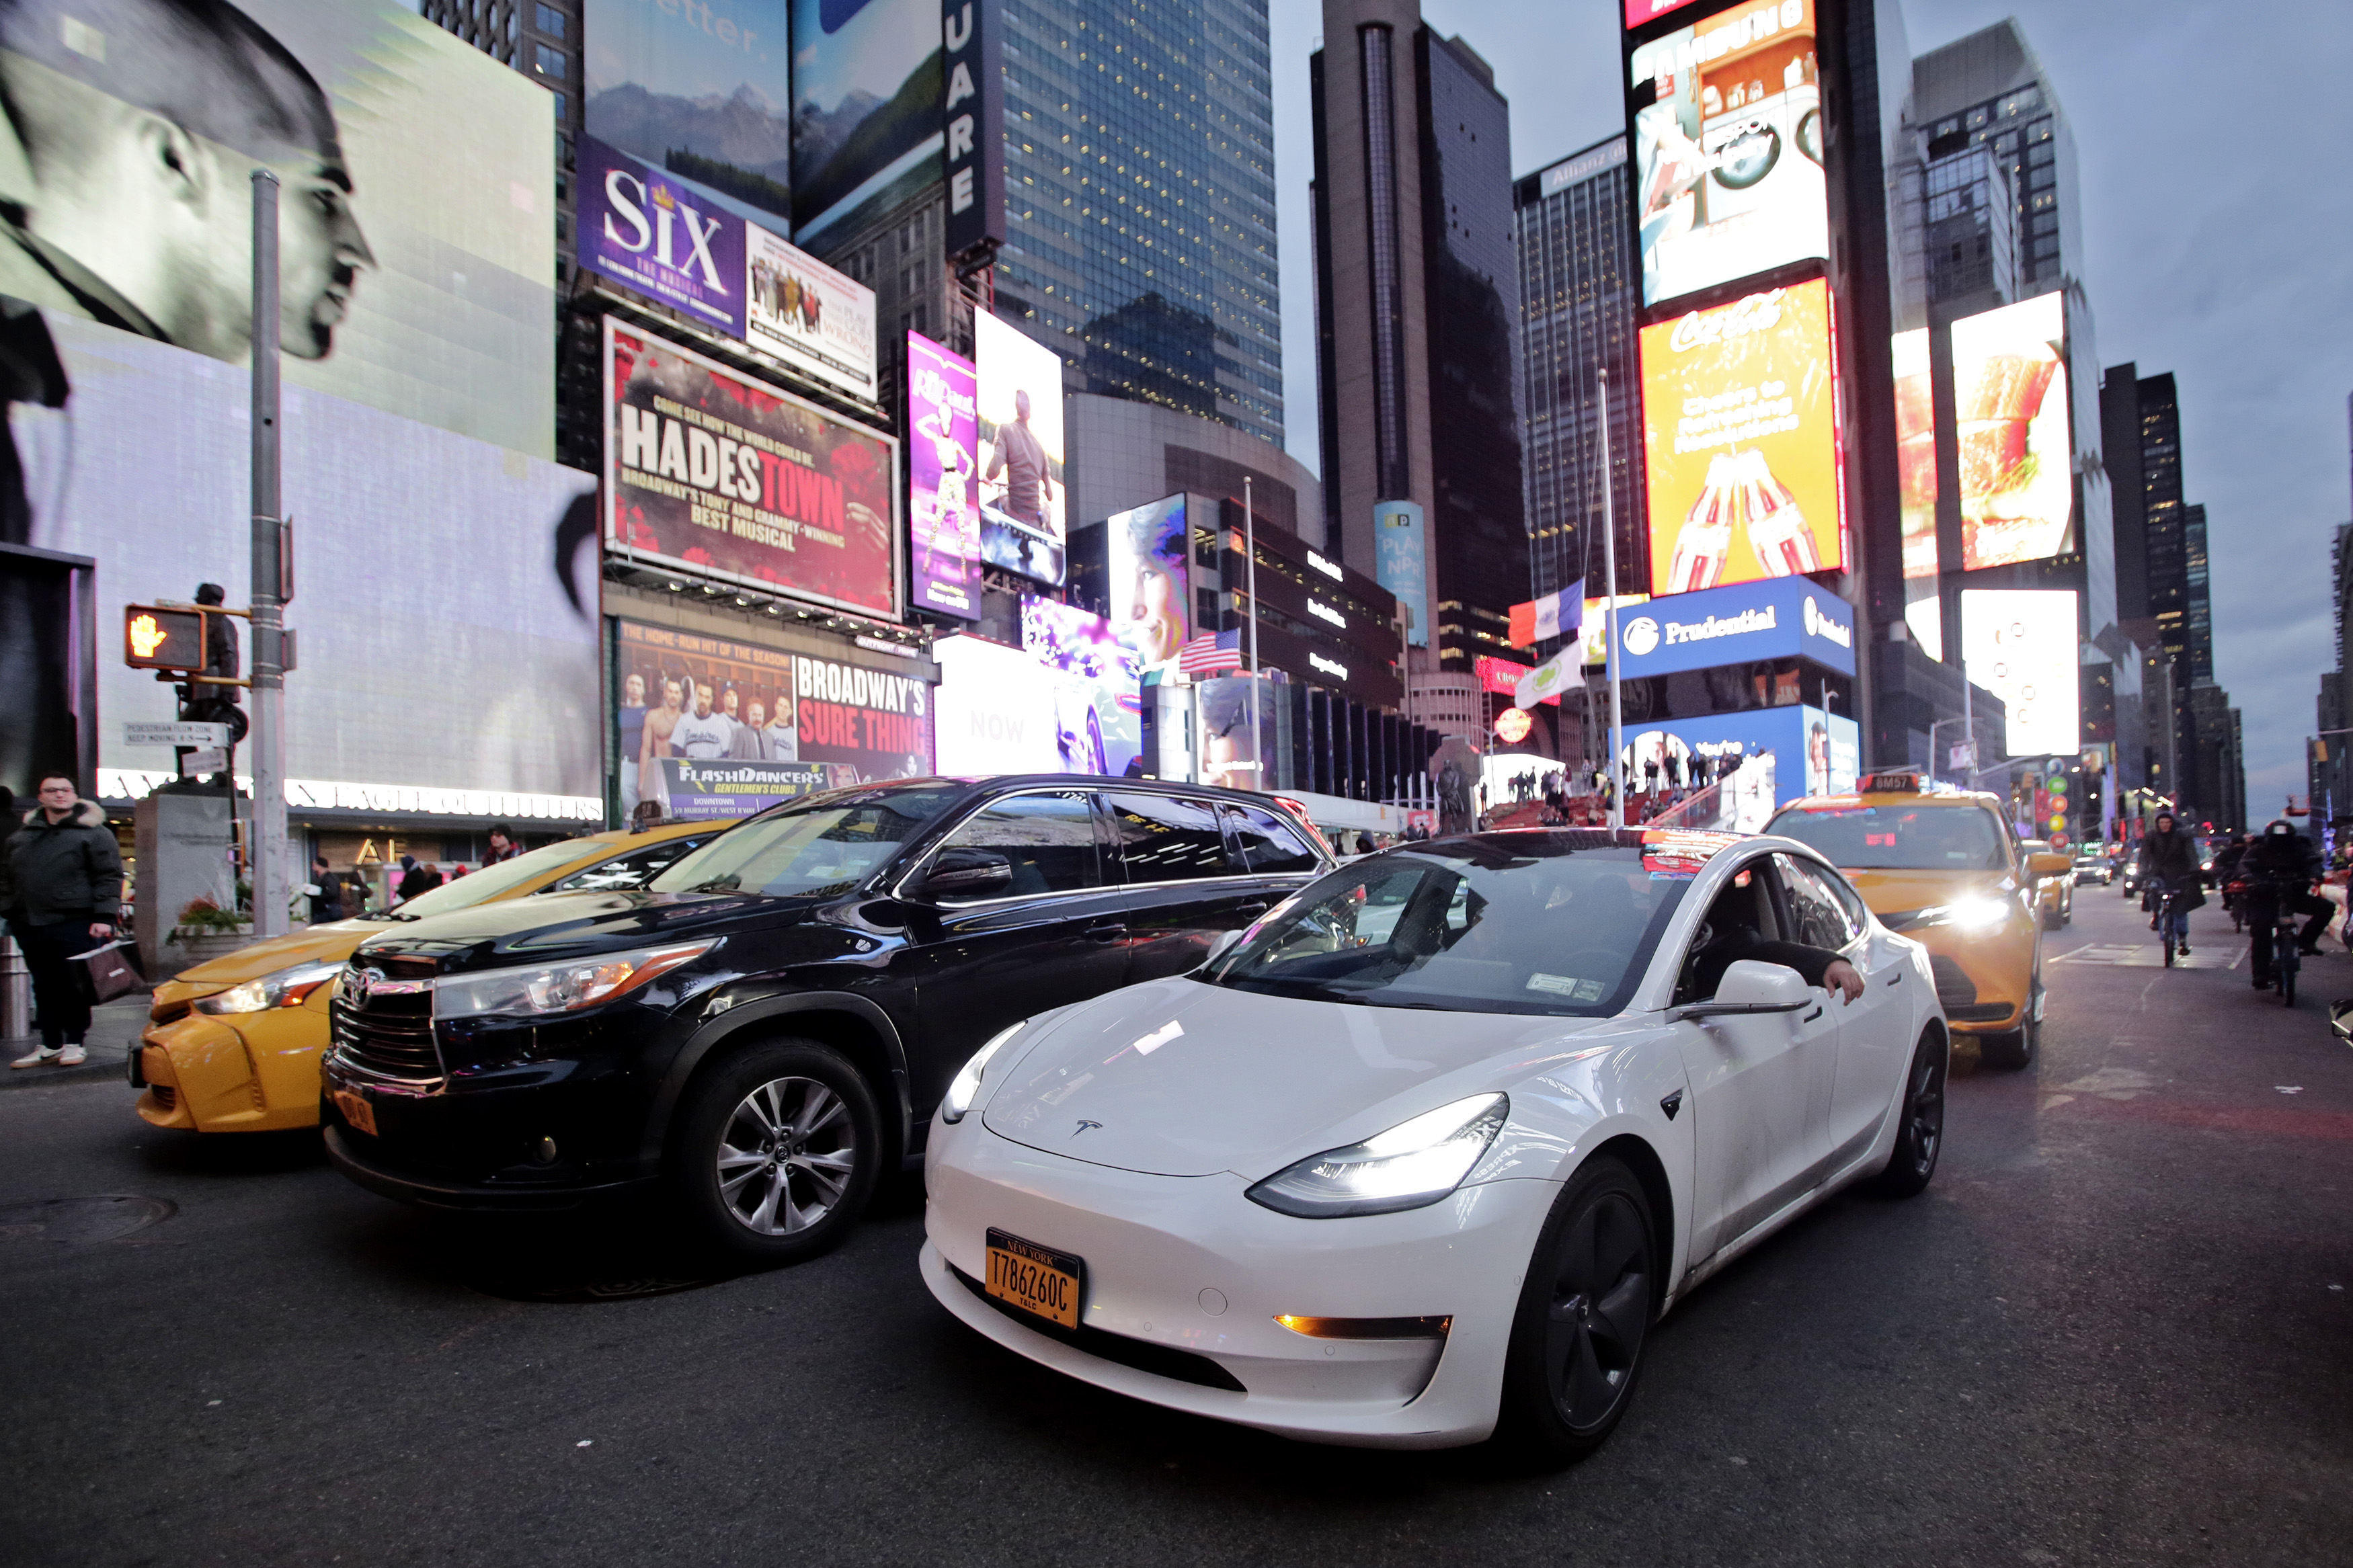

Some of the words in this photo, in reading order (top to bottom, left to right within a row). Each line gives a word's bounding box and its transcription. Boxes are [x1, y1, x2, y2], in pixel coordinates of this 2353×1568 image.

[1552, 152, 1605, 186] Allianz
[604, 169, 729, 297] SIX
[1678, 397, 1792, 438] Refreshing
[1683, 386, 1757, 417] Cheers
[1759, 380, 1786, 399] to
[653, 395, 683, 419] COME
[684, 406, 701, 427] SEE
[702, 413, 725, 435] HOW
[725, 421, 744, 442] THE
[744, 429, 775, 454] WORLD
[774, 441, 802, 464] COULD
[621, 403, 845, 532] HADESTOWN
[622, 467, 700, 504] BROADWAY'S
[699, 490, 731, 513] TONY
[731, 501, 754, 522] AND
[691, 503, 731, 533] BEST
[731, 516, 797, 546] MUSICAL
[1665, 605, 1777, 645] Prudential
[623, 623, 643, 640] THE
[645, 626, 701, 651] HOME-RUN
[701, 638, 717, 655] HIT
[719, 641, 732, 657] OF
[733, 645, 751, 661] THE
[752, 649, 791, 668] SEASON!
[858, 637, 895, 655] OUTFRONT
[798, 657, 925, 717] BROADWAY'S
[126, 725, 172, 733] PEDESTRIAN
[127, 734, 147, 742] KEEP
[149, 735, 176, 743] MOVING
[799, 699, 860, 749] SURE
[862, 709, 926, 757] THING
[971, 710, 1024, 743] NOW
[693, 797, 735, 806] DOWNTOWN
[714, 783, 769, 794] GENTLEMEN'S
[770, 784, 797, 795] CLUBS
[684, 807, 710, 815] MURRAY
[1007, 1240, 1028, 1256] NEW
[1029, 1249, 1054, 1267] YORK
[992, 1250, 1068, 1312] T786260C
[1019, 1296, 1037, 1311] T&LC
